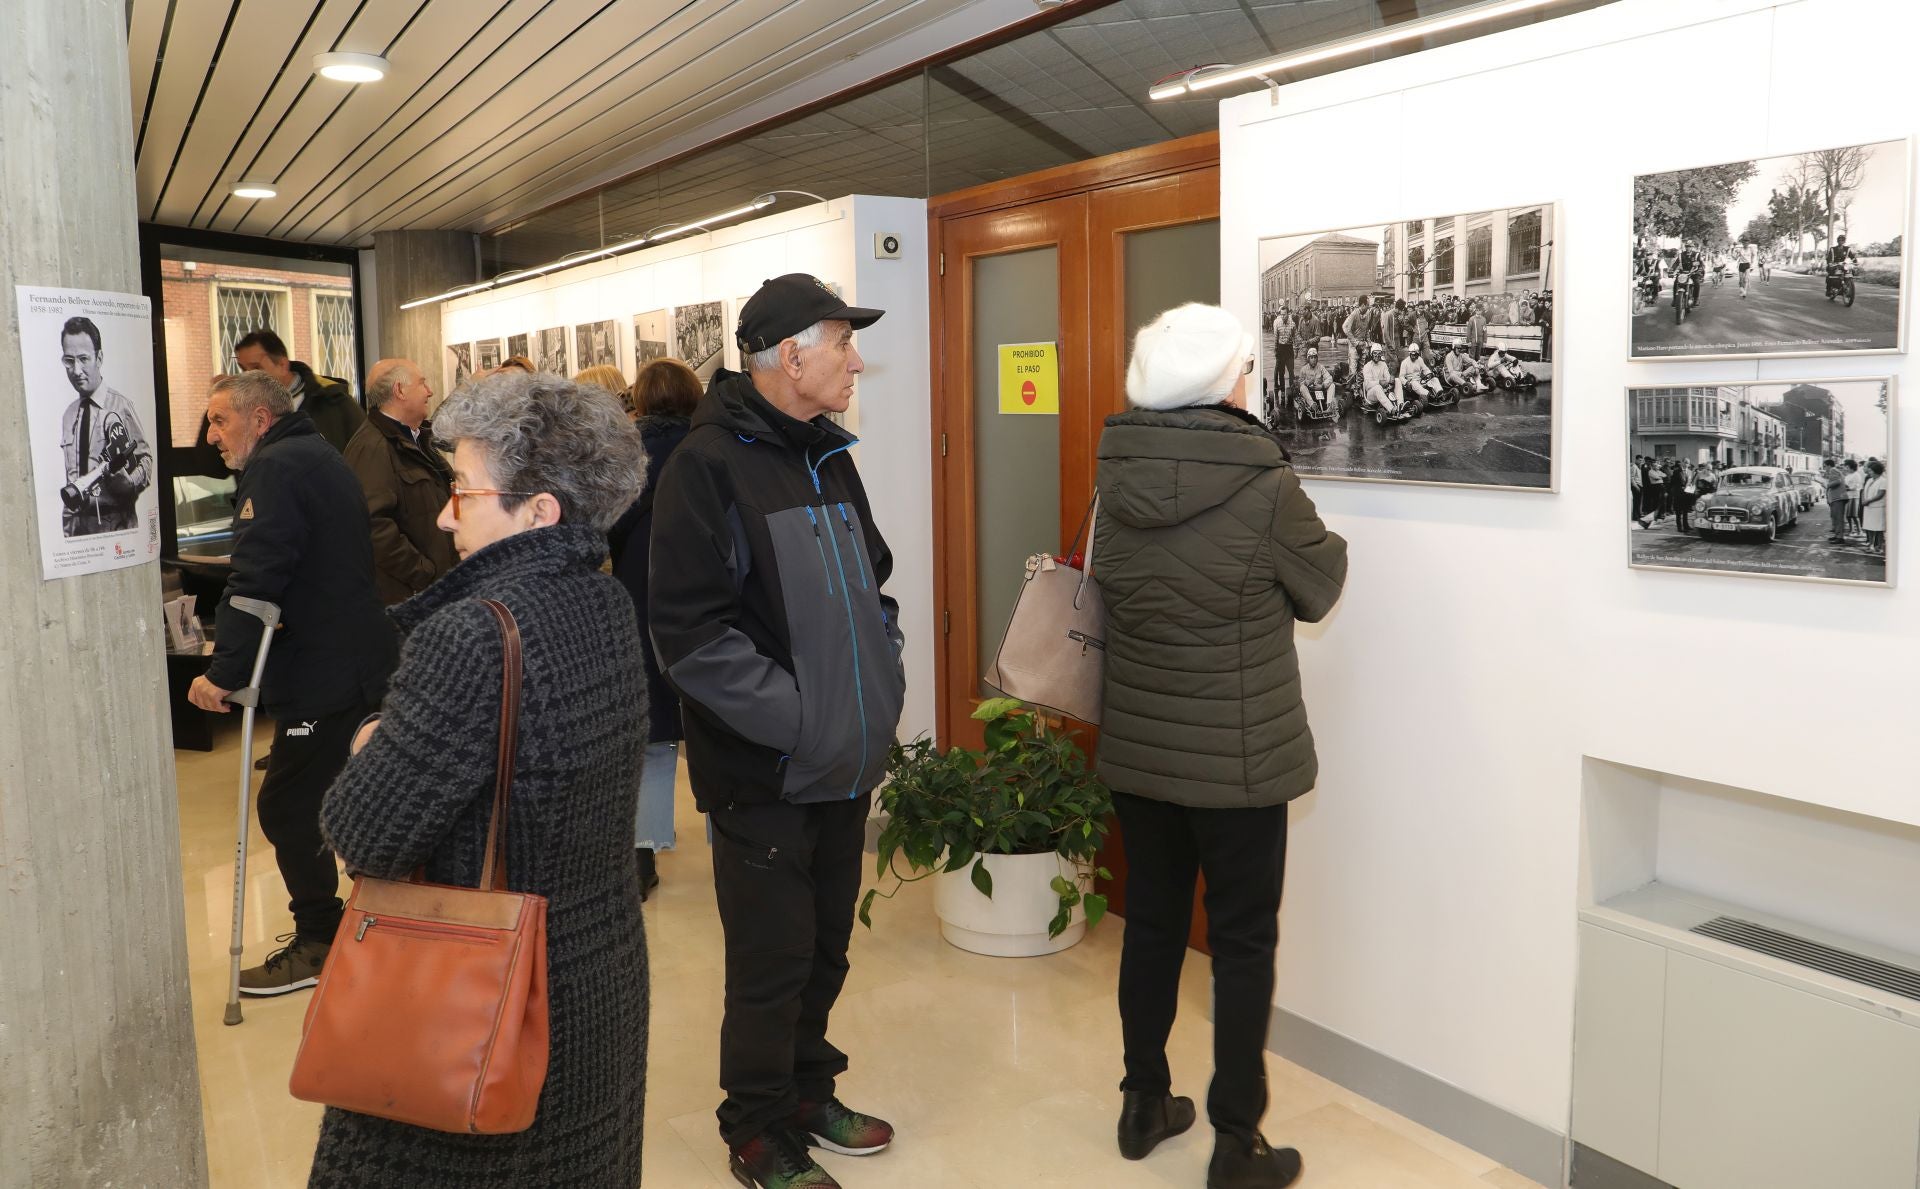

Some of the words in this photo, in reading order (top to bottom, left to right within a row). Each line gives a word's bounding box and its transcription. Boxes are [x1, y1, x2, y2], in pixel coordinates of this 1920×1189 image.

[30, 294, 67, 304] Fernando
[68, 296, 91, 306] Bellver
[1012, 350, 1044, 358] PROHIBIDO
[111, 426, 123, 439] TVE
[287, 728, 309, 736] PUMA
